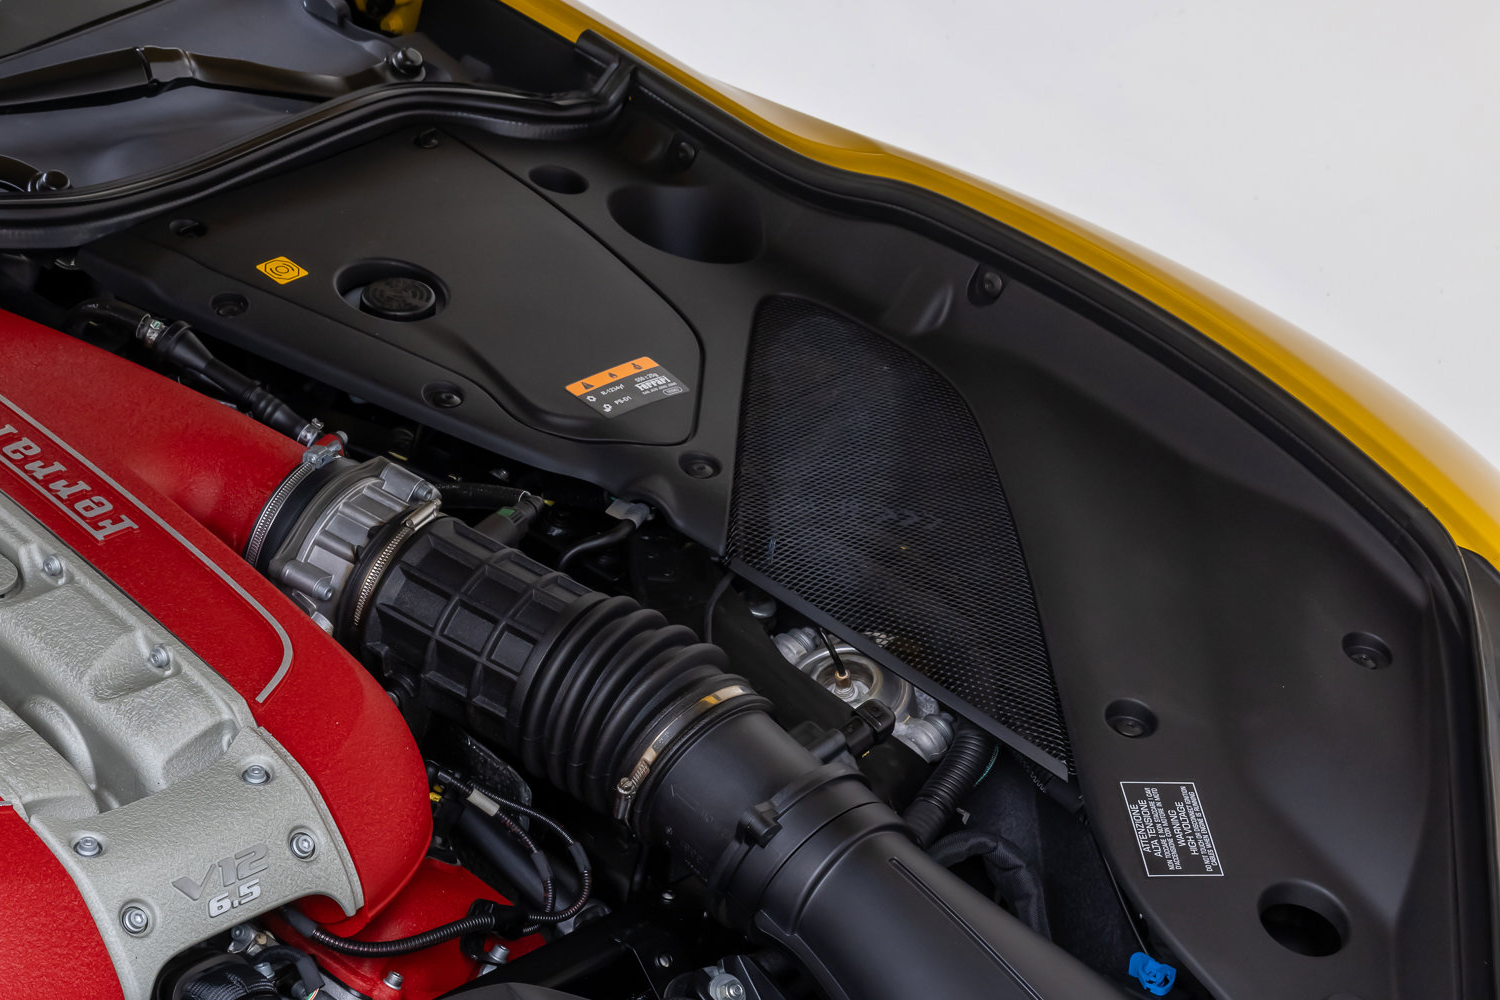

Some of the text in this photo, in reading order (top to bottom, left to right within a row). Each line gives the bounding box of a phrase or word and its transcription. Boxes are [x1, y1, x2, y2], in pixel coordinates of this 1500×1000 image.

[634, 374, 671, 391] Ferrari
[1129, 804, 1151, 851] ATTENZIONE
[1137, 799, 1163, 856] ALTA TENSIONE
[1167, 809, 1186, 846] WARNING
[1174, 801, 1199, 854] HIGH VOLTAGE
[172, 844, 269, 901] V12
[1166, 860, 1175, 869] NON
[208, 878, 261, 918] 6.5
